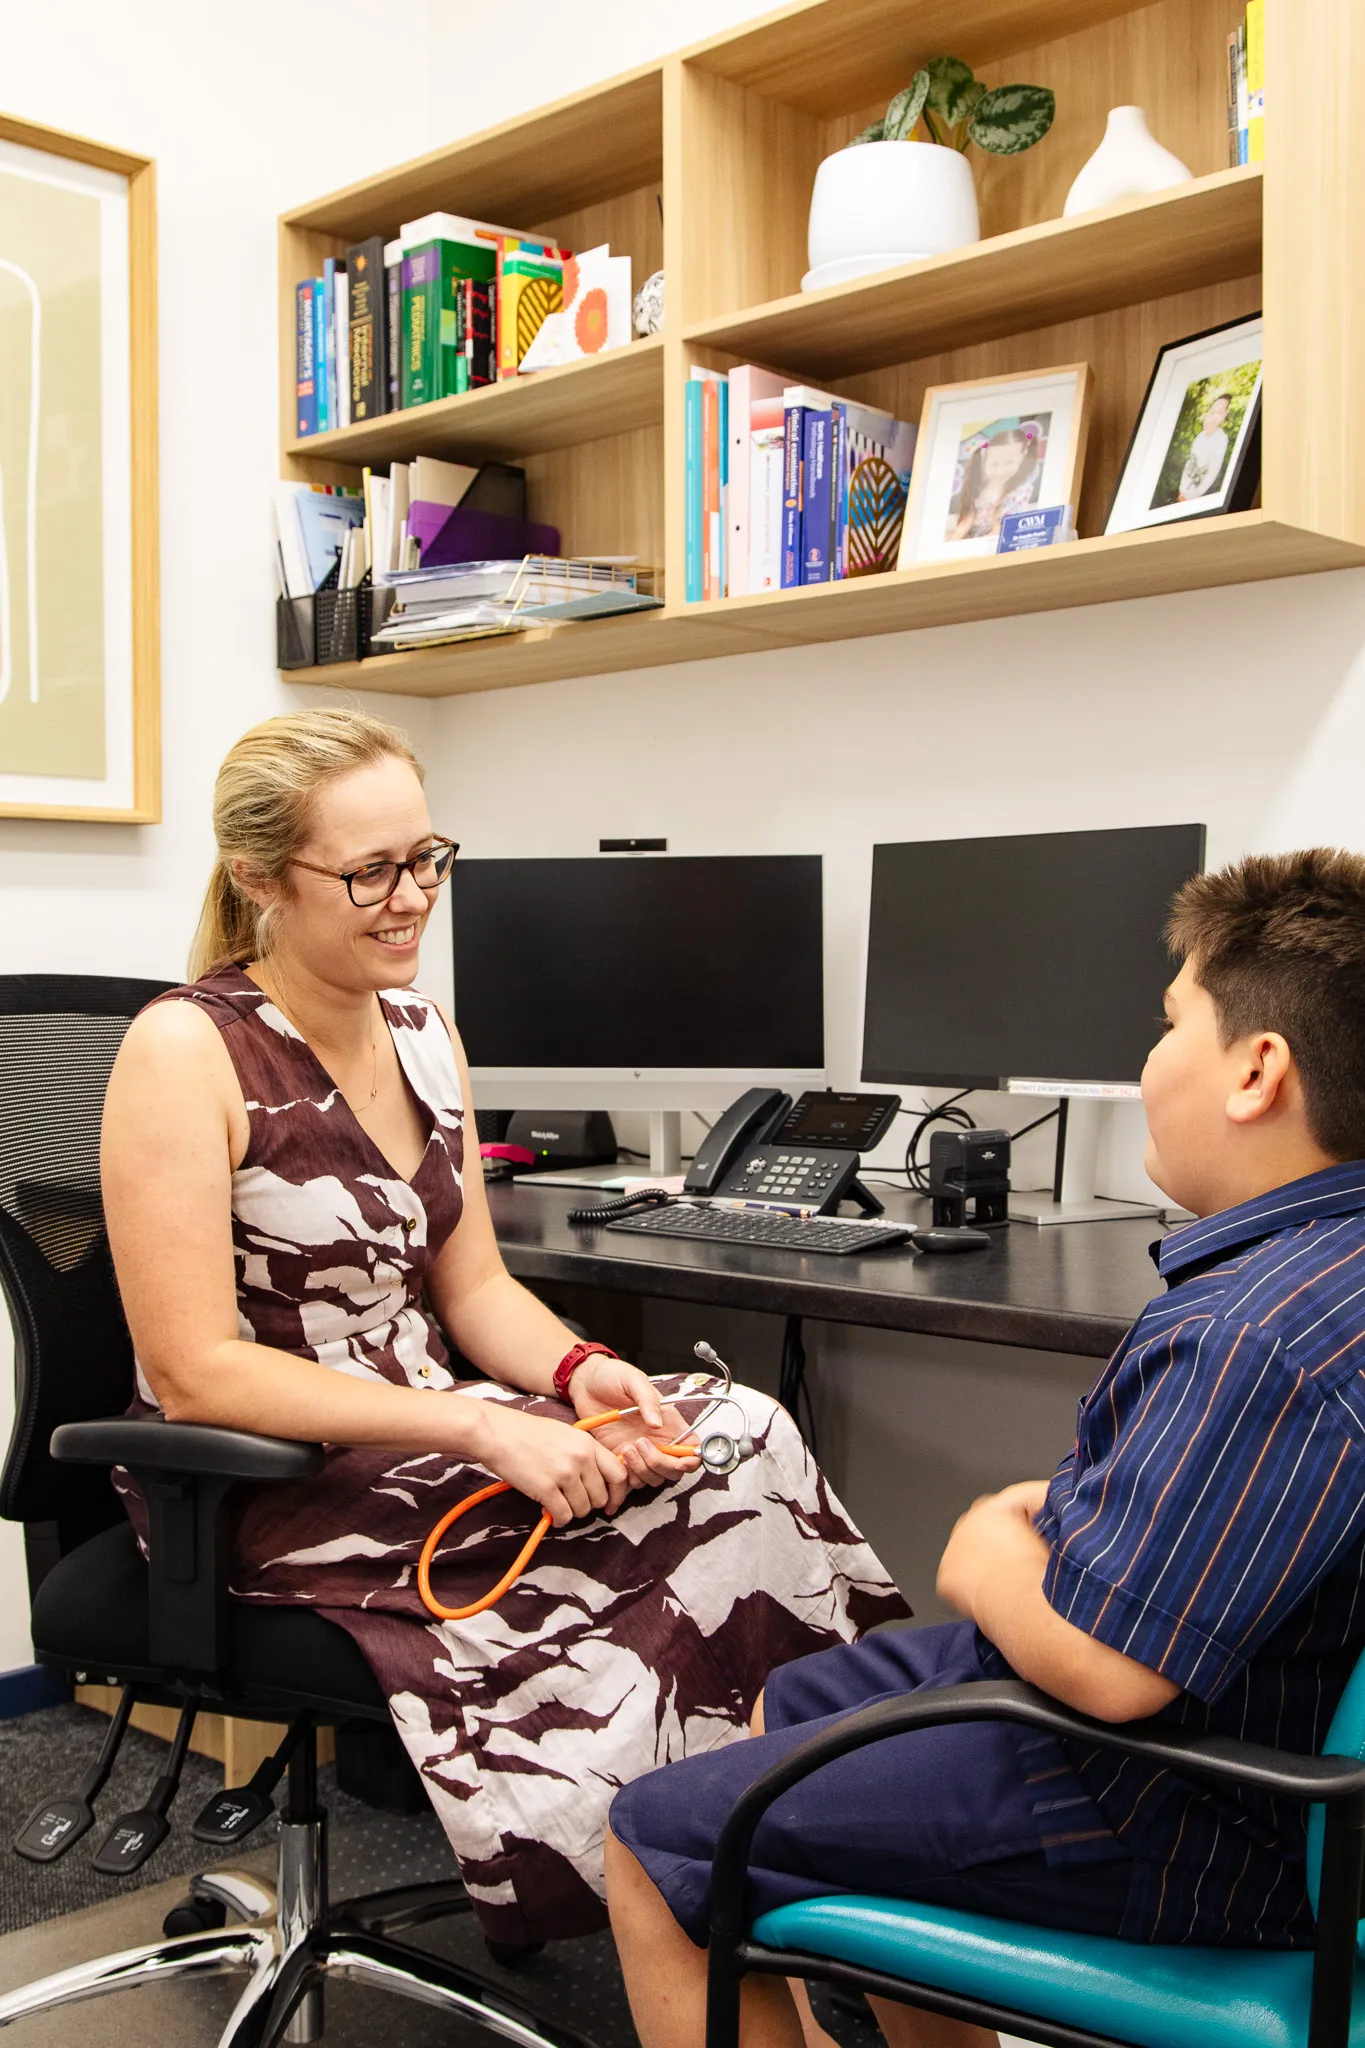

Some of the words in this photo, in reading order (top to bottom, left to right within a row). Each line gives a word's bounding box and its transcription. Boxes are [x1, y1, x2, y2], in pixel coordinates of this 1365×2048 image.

[791, 408, 799, 442] clinical
[809, 421, 818, 459] Pathology
[790, 442, 798, 497] examination
[809, 459, 817, 499] Handbook
[816, 441, 824, 480] Healthcare
